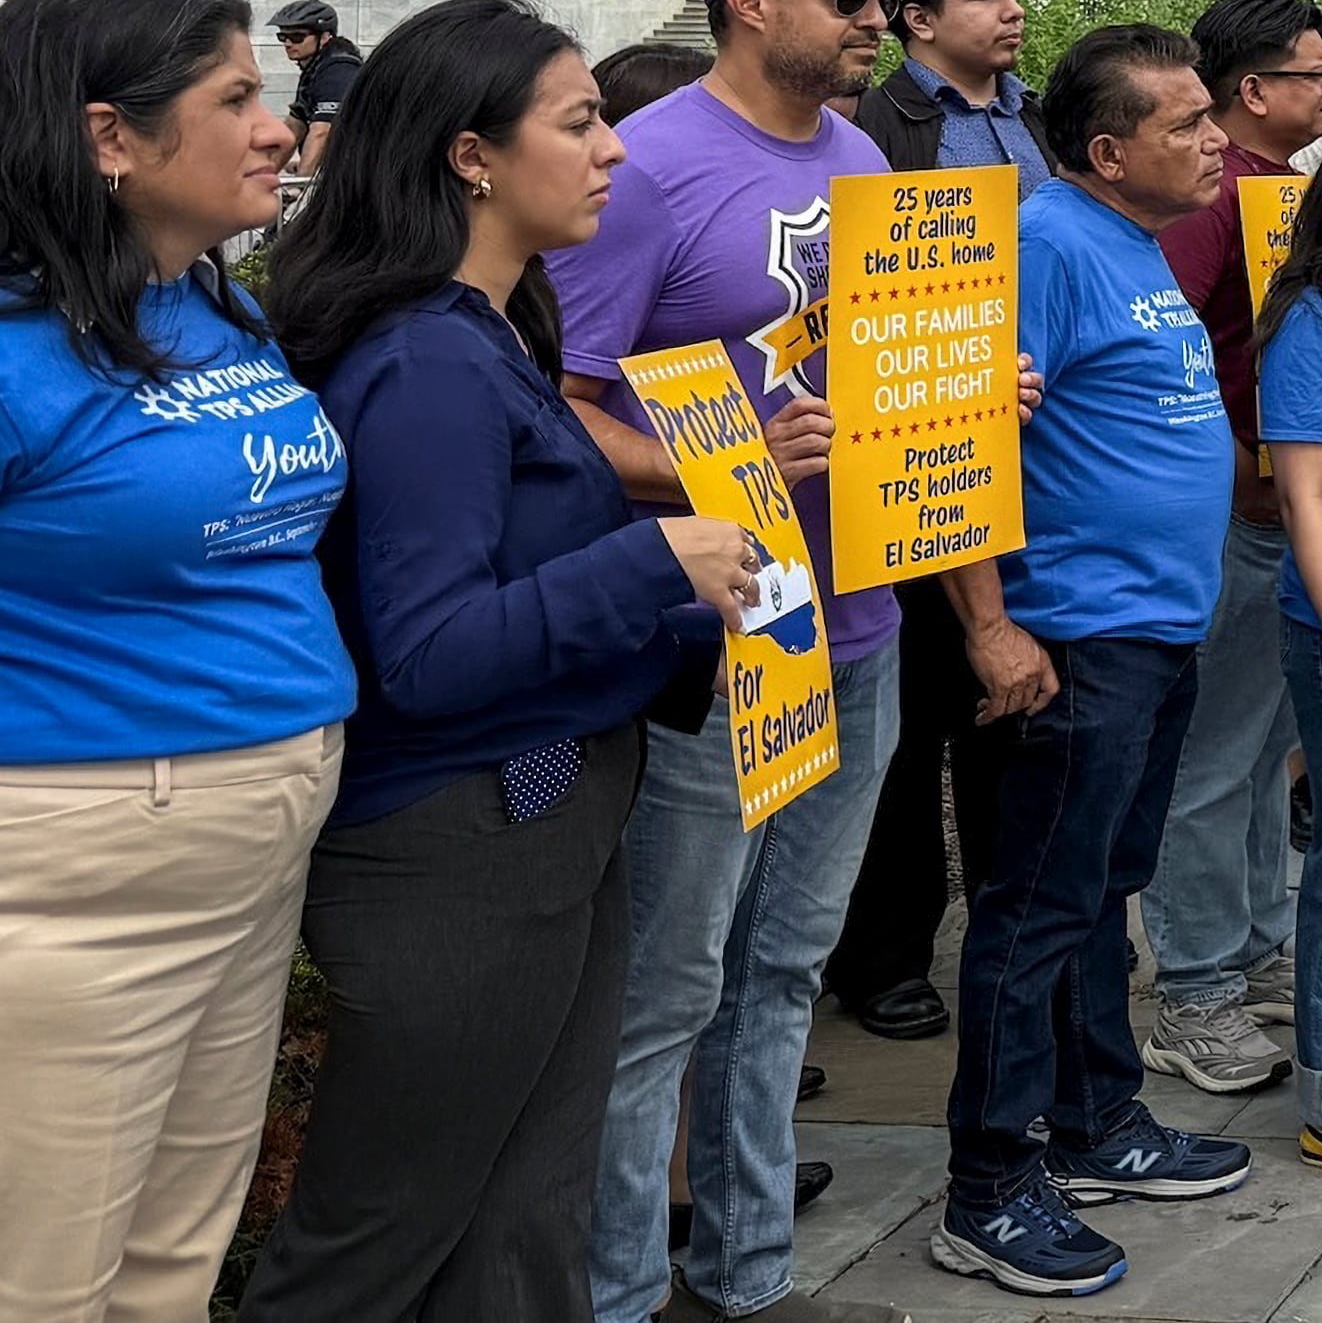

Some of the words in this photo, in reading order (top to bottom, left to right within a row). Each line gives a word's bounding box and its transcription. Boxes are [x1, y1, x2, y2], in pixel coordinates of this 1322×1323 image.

[893, 186, 918, 212] 25
[925, 185, 972, 217] years
[1279, 185, 1296, 204] 25
[889, 216, 913, 243] of
[917, 211, 976, 240] calling
[796, 242, 823, 264] WE
[863, 248, 900, 276] the
[906, 244, 945, 271] U.S.
[951, 241, 995, 265] home
[851, 313, 907, 345] OUR
[915, 298, 1005, 344] FAMILIES
[877, 346, 929, 378] OUR
[937, 335, 991, 368] LIVES
[171, 359, 284, 401] NATIONAL
[874, 381, 927, 413] OUR
[936, 368, 994, 401] FIGHT
[198, 396, 254, 421] TPS
[645, 381, 758, 465] Protect
[904, 436, 975, 477] Protect
[731, 456, 790, 530] TPS
[878, 477, 920, 508] TPS
[927, 465, 992, 498] holders
[918, 504, 964, 531] from
[885, 539, 903, 568] El
[910, 518, 990, 563] Salvador
[733, 661, 764, 714] for
[737, 719, 756, 777] El
[761, 685, 831, 764] Salvador
